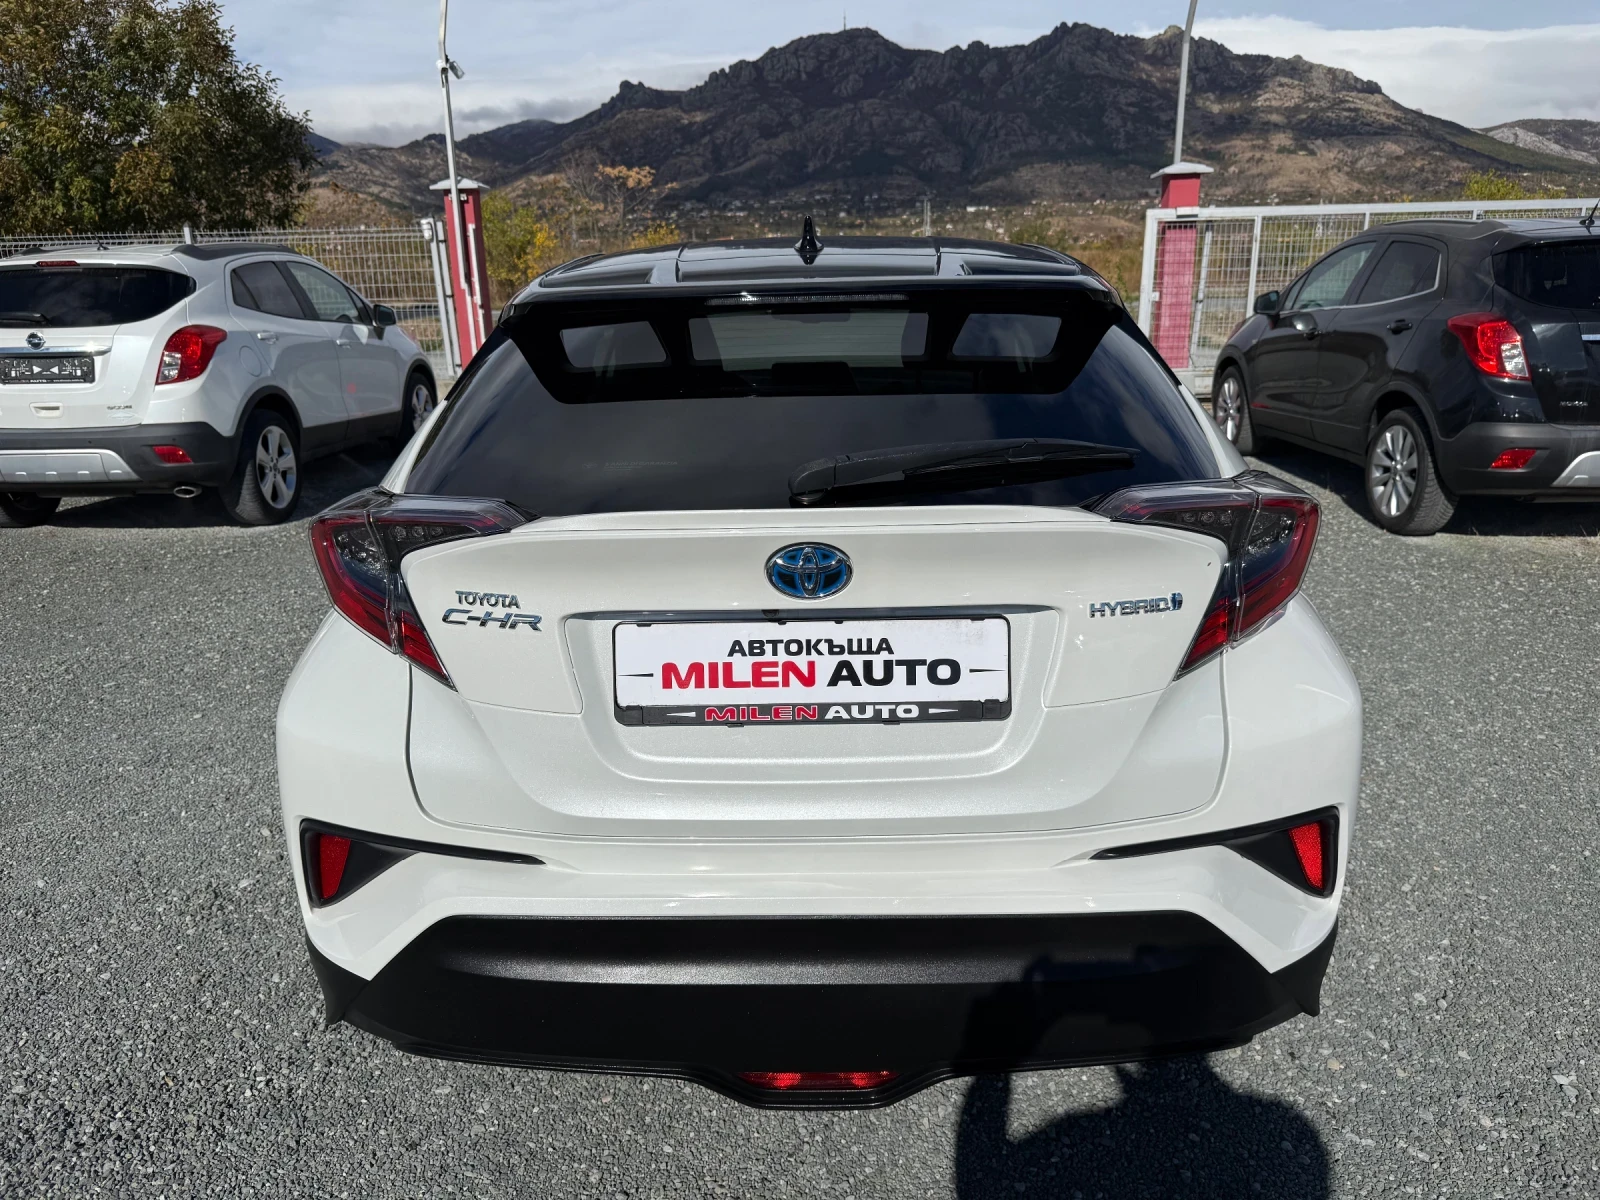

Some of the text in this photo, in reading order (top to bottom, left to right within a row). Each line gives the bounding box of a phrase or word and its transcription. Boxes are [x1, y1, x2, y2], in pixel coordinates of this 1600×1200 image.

[455, 590, 521, 609] TOYOTA
[1089, 597, 1171, 618] HYBRID
[442, 608, 543, 632] C-HR
[661, 658, 962, 690] MILEN AUTO
[704, 704, 920, 721] MILEN AUTO
